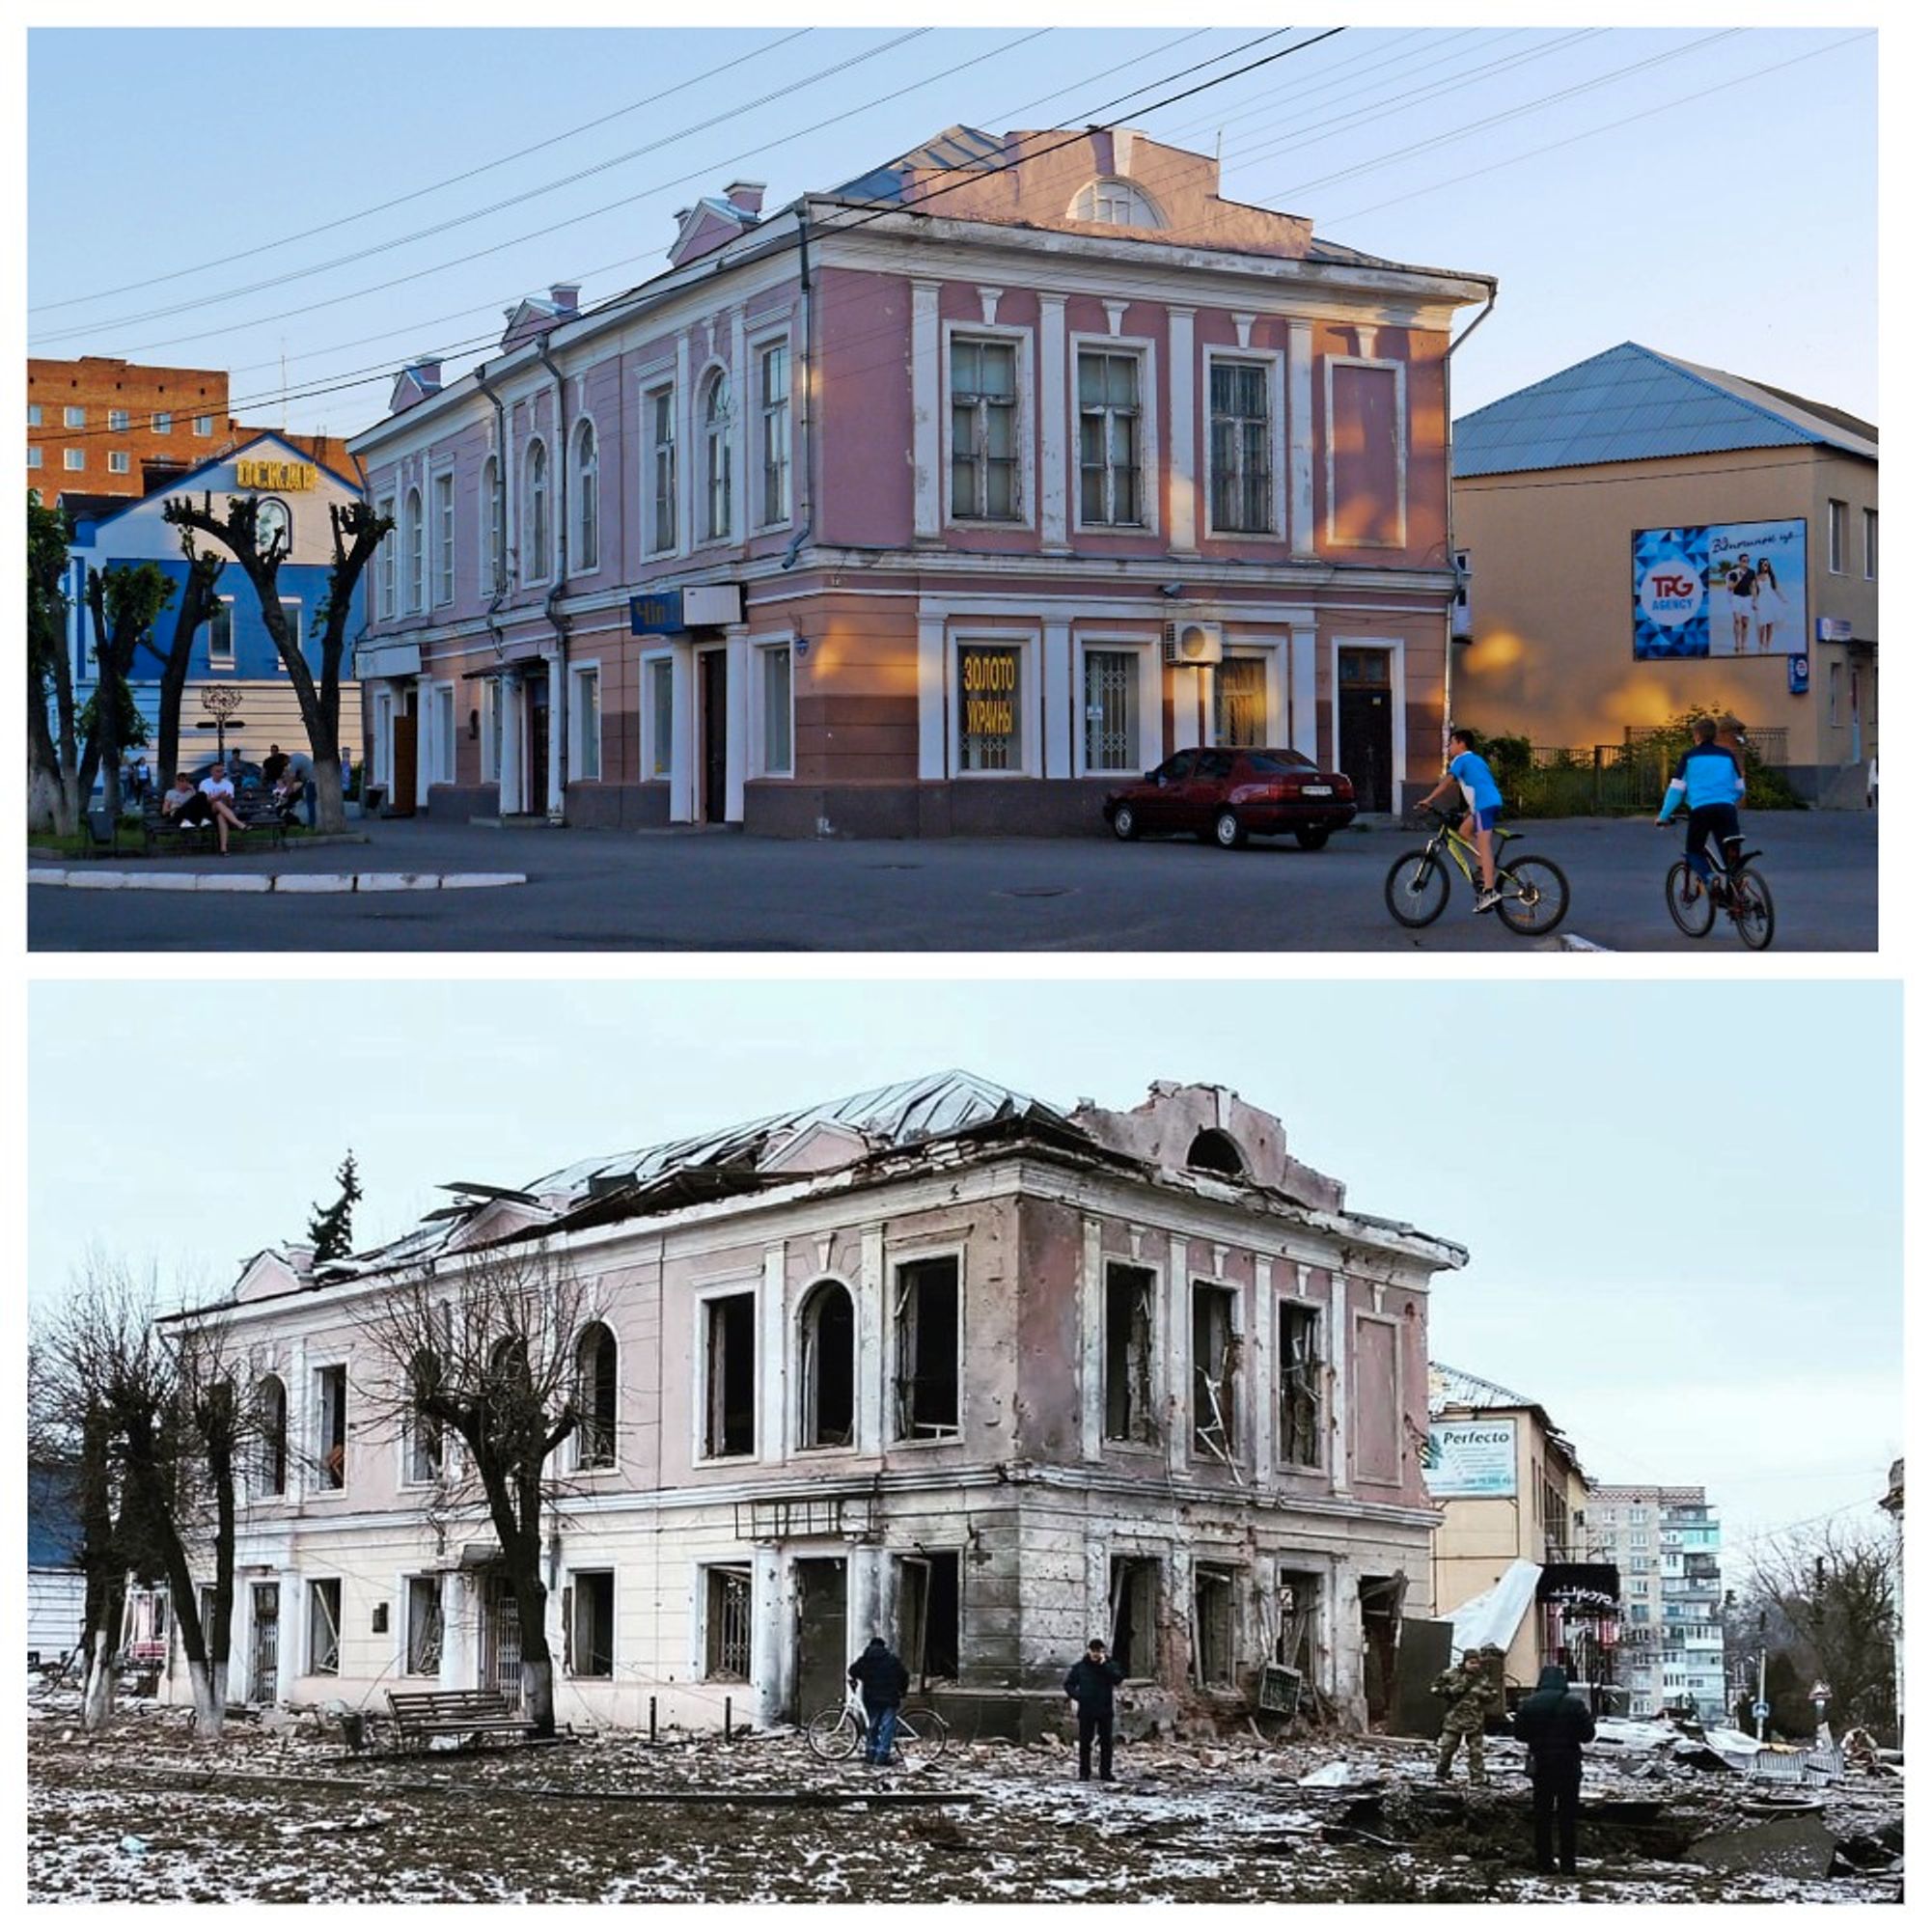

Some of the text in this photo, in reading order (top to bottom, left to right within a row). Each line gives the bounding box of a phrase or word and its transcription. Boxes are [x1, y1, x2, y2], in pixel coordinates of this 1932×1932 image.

[1651, 575, 1695, 597] TPG
[1652, 598, 1694, 611] AGENCY
[965, 656, 1015, 692] ЗОЛОТО
[1444, 1430, 1510, 1445] Perfecto
